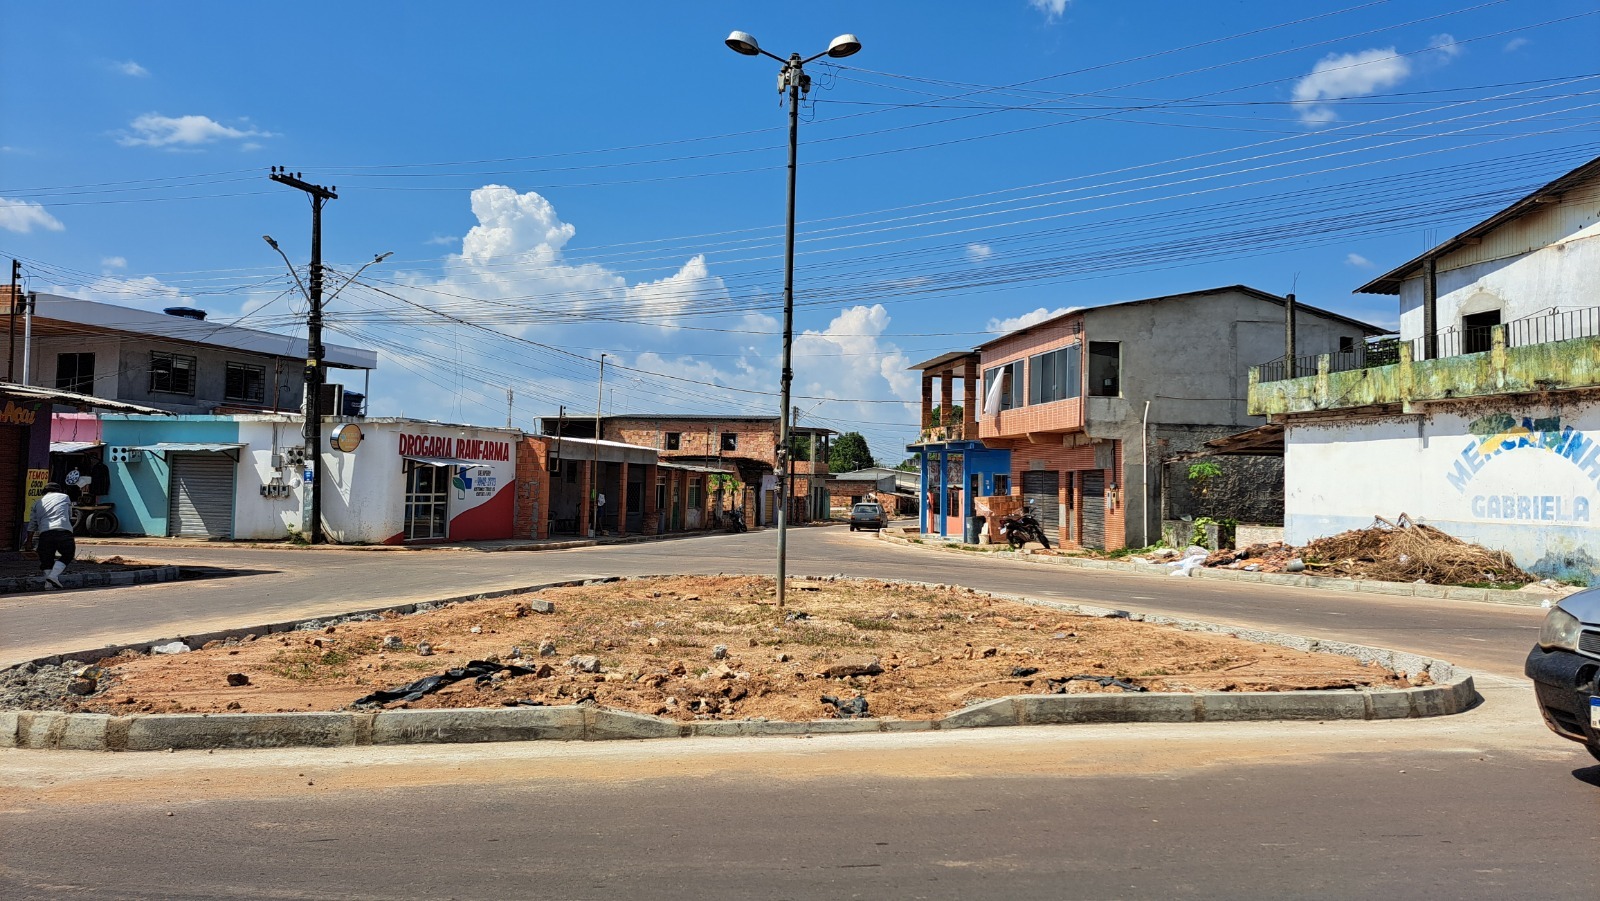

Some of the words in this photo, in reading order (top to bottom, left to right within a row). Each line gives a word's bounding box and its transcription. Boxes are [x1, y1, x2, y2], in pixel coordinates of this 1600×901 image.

[399, 433, 452, 458] DROGARIA
[455, 438, 509, 461] IRANFARMA
[28, 470, 49, 480] TEMOS
[30, 480, 43, 488] COCO
[28, 488, 43, 497] GELAD
[1471, 495, 1590, 522] GABRIELA
